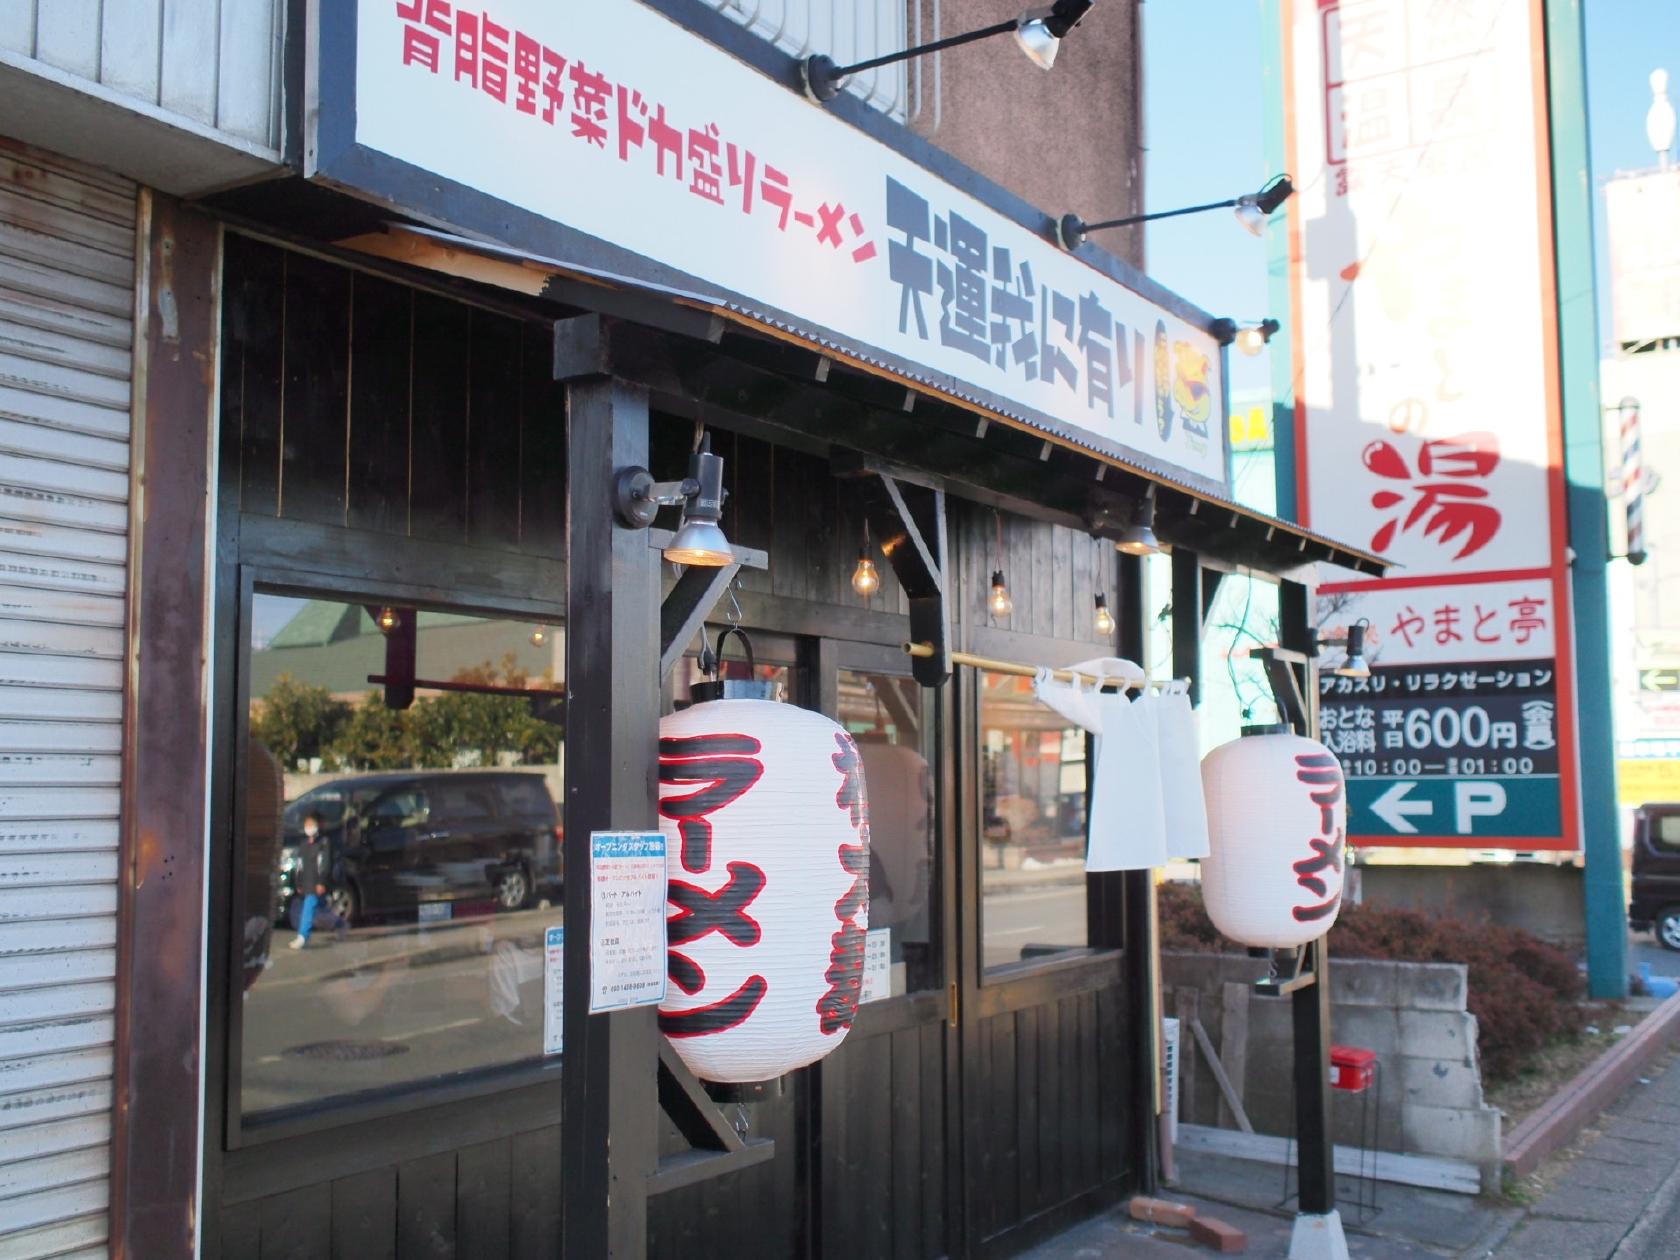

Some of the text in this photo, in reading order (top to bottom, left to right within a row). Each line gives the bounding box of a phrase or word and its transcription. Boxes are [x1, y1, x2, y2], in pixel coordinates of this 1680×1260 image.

[1391, 597, 1547, 648] やまと亭
[1319, 669, 1552, 695] アカスリ・リラクゼーション
[1455, 781, 1507, 834] P
[658, 733, 768, 1039] ラーメン
